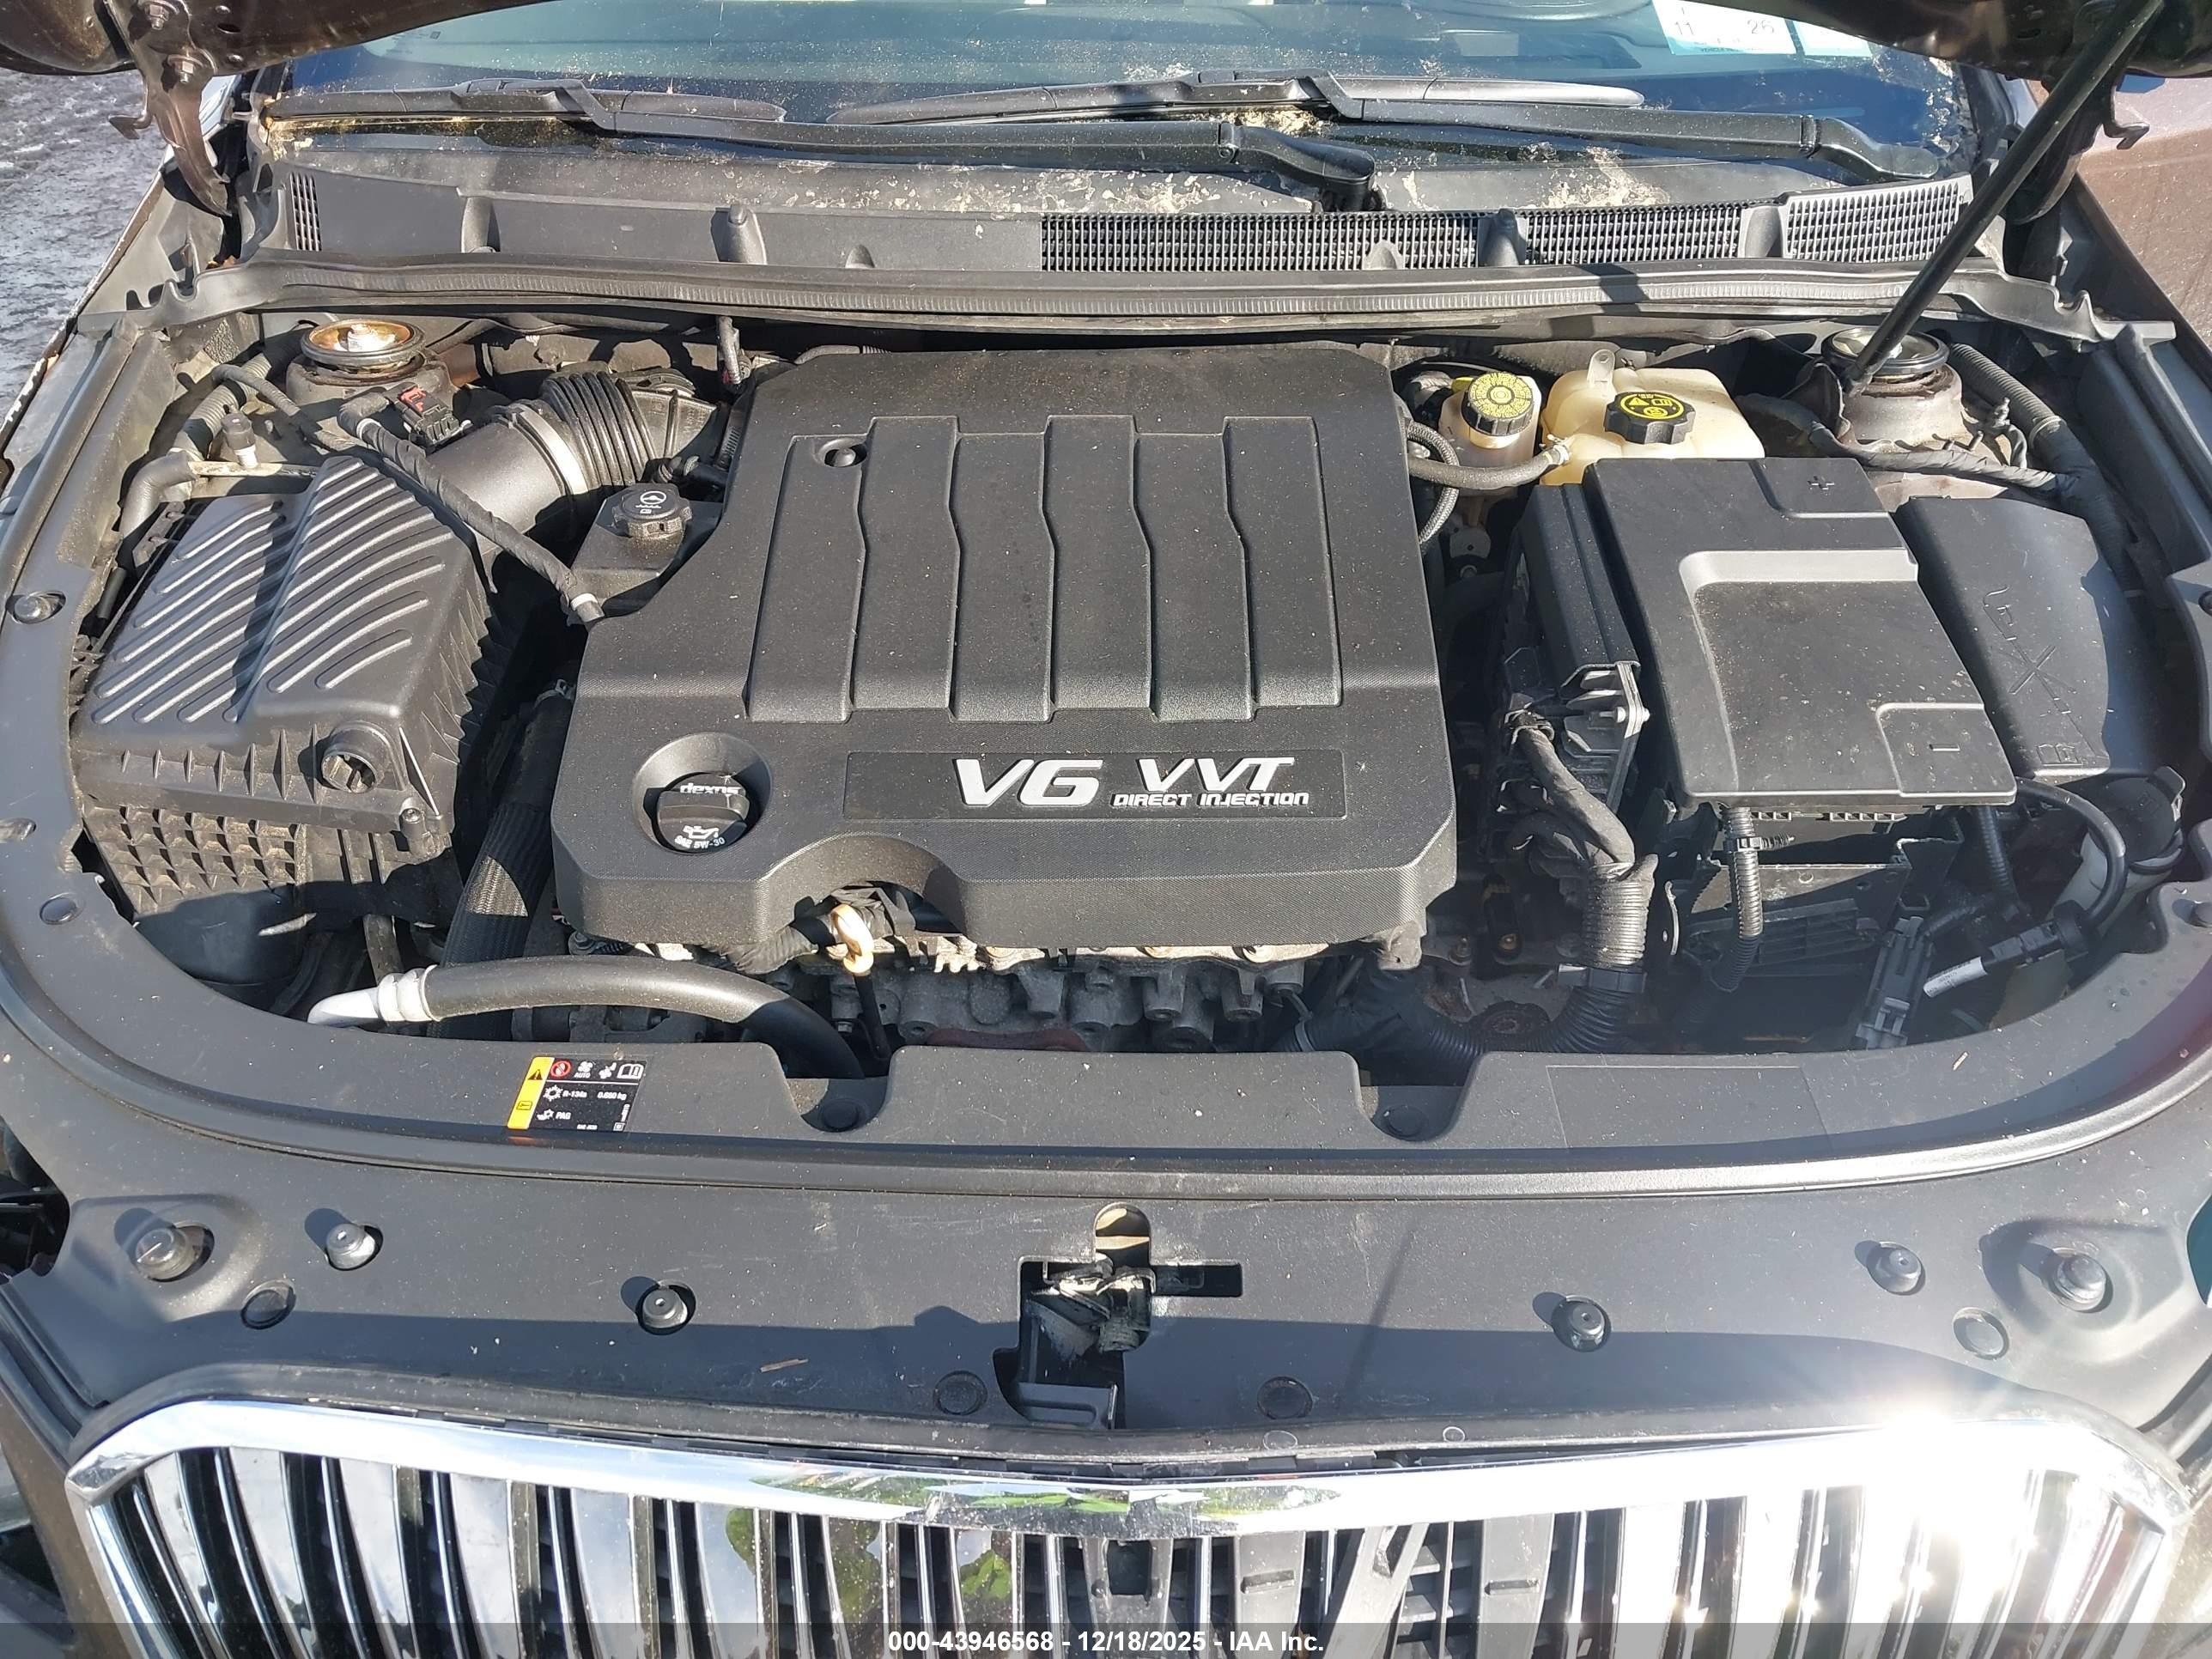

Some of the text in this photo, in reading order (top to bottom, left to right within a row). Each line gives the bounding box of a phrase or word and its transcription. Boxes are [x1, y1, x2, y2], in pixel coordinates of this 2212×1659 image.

[952, 756, 1296, 807] V6 VVT
[1111, 791, 1310, 807] DIRECT INJECTION
[674, 835, 726, 850] SAE 5W-30
[555, 1111, 572, 1120] PAG
